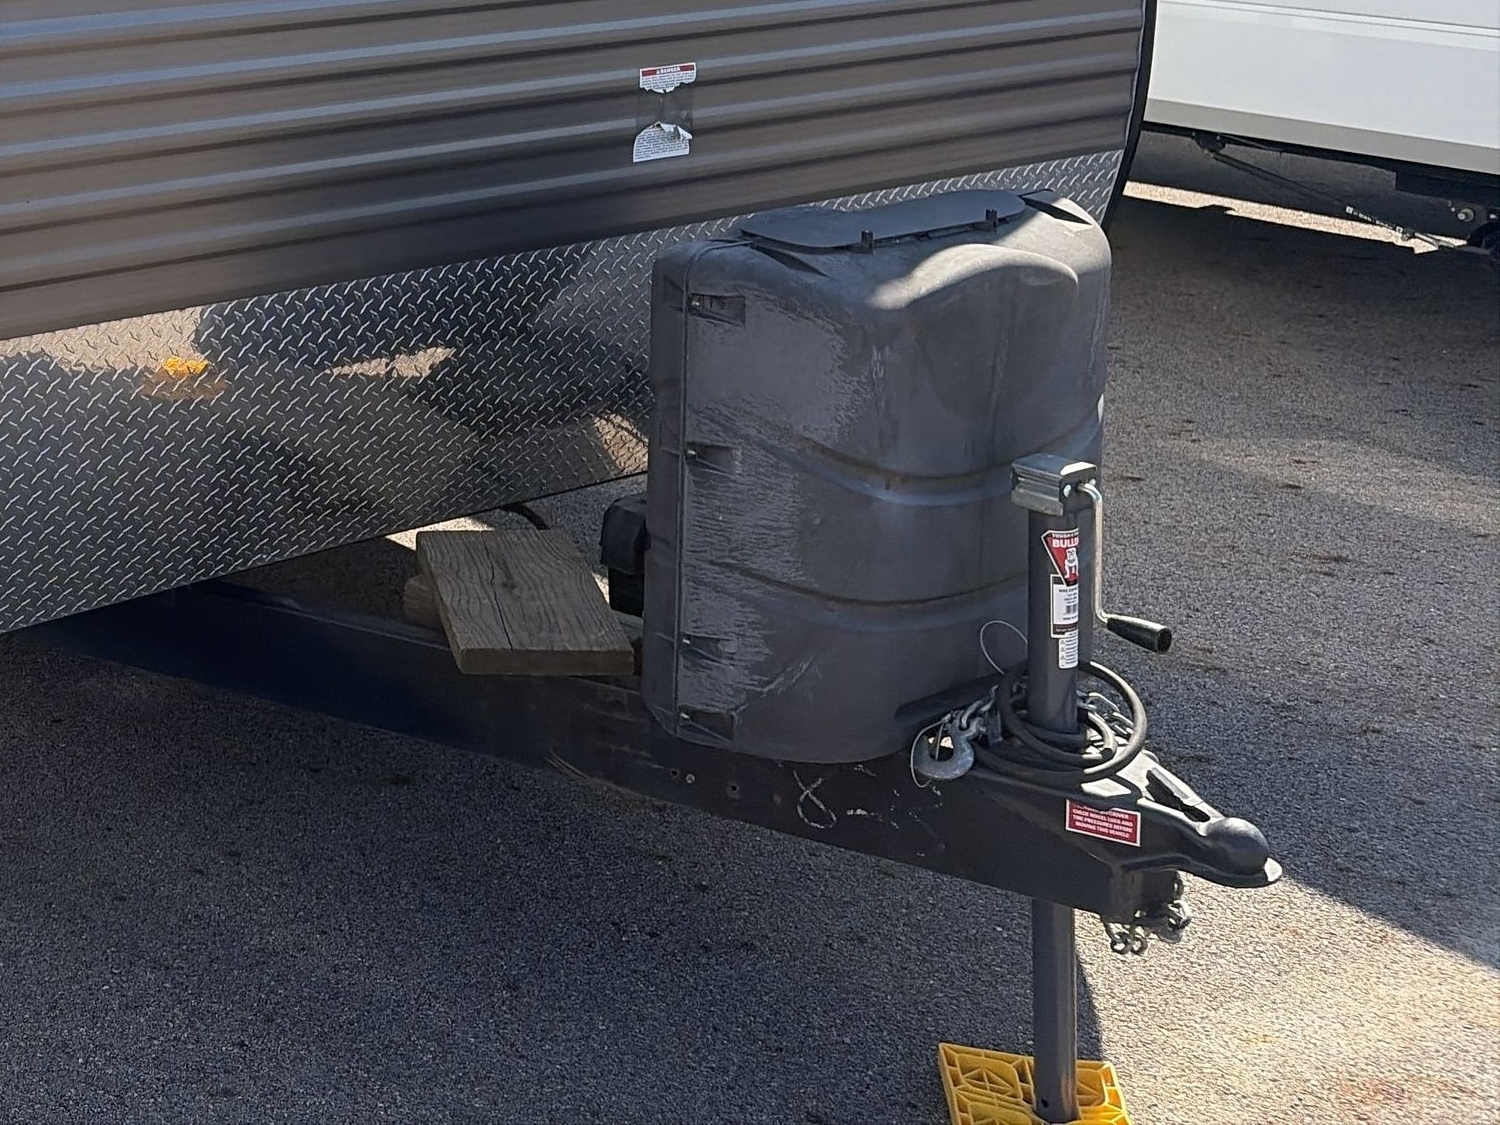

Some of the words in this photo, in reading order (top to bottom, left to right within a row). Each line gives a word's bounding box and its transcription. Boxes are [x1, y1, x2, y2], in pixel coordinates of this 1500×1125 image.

[1072, 808, 1089, 816] CHECK
[1089, 812, 1107, 820] WHEEL
[1107, 816, 1121, 824] LUGS
[1121, 819, 1133, 827] AND
[1072, 814, 1084, 822] TIRE
[1084, 817, 1113, 828] PRESSURES
[1113, 824, 1133, 833] BEFORE
[1075, 821, 1096, 830] MOVING
[1096, 825, 1109, 834] THIS
[1109, 828, 1130, 838] VEHICLE
